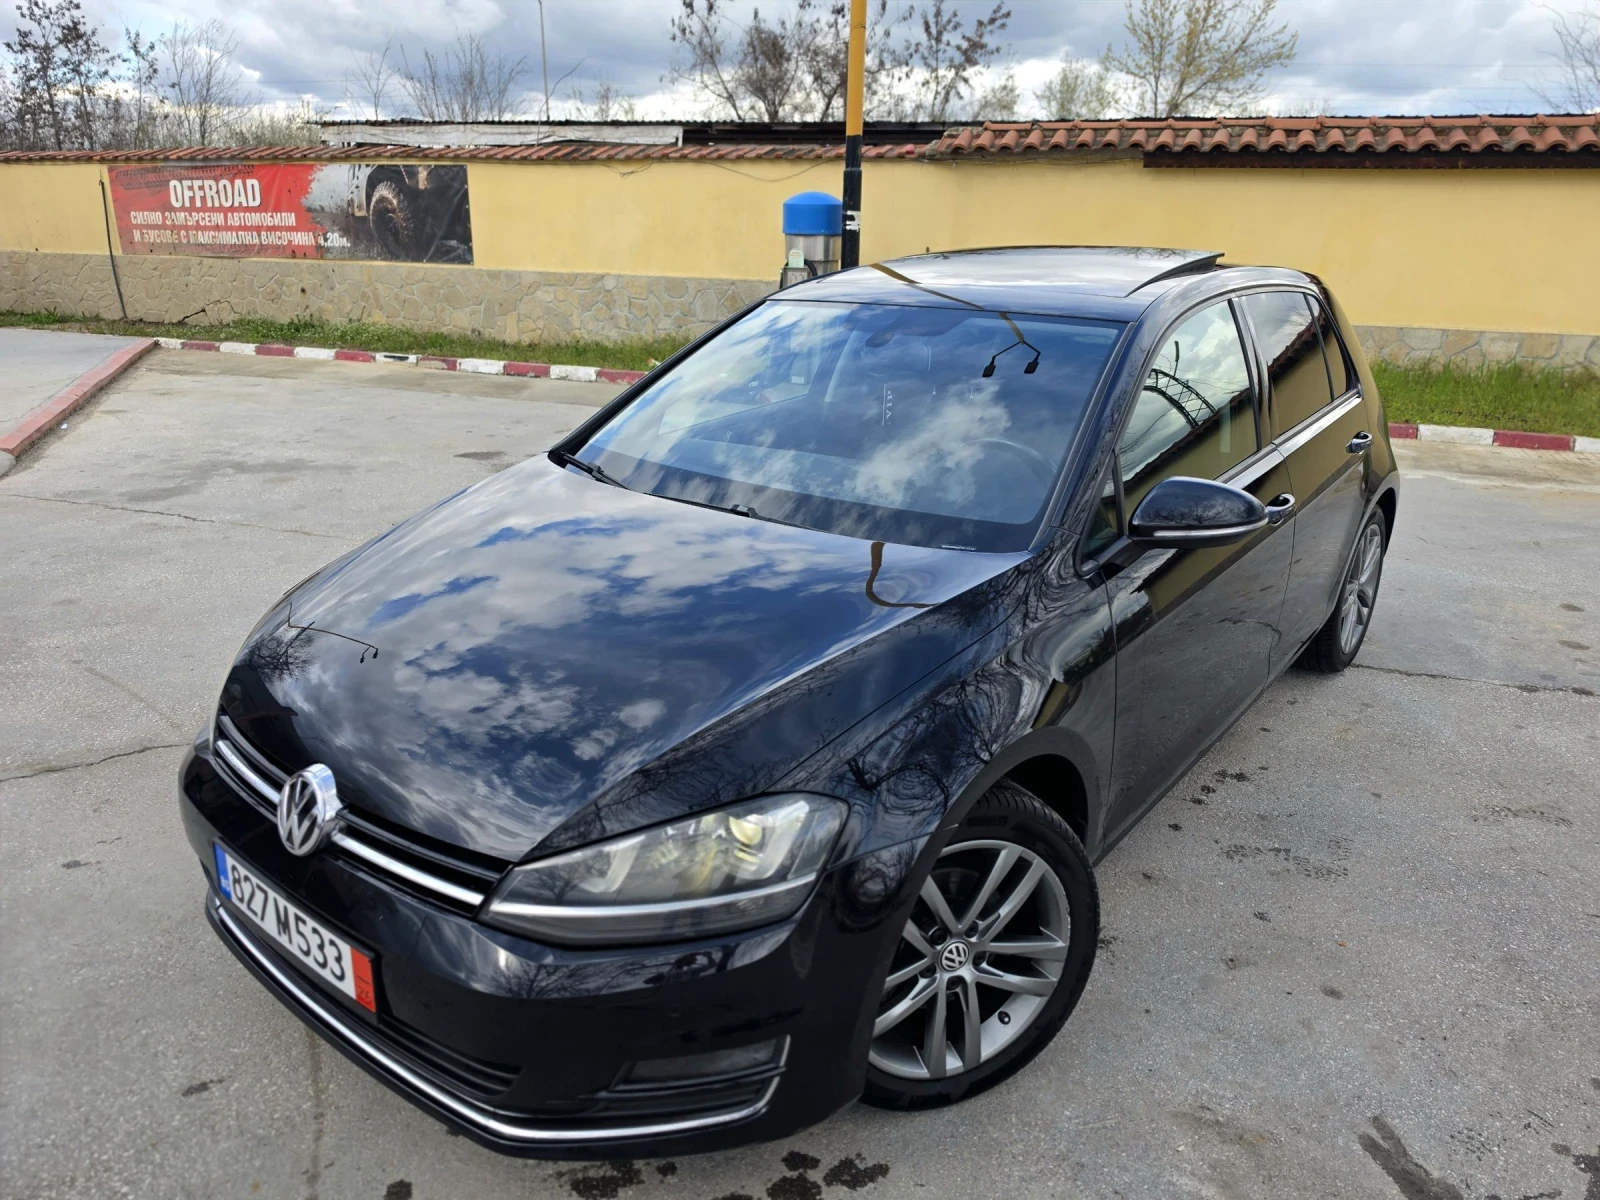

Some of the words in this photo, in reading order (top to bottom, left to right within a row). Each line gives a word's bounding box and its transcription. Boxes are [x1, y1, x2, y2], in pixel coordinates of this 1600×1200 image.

[169, 179, 262, 208] OFFROAD
[130, 211, 162, 225] СИЛНО
[164, 211, 225, 226] ЗАМЪРСЕНИ
[227, 211, 296, 227] АВТОМОБИЛИ
[133, 229, 141, 242] И
[142, 230, 179, 244] БУСОВЕ
[180, 230, 188, 243] С
[189, 230, 259, 245] МАКСИМАЛНА
[261, 231, 316, 246] ВИСОЧИНА
